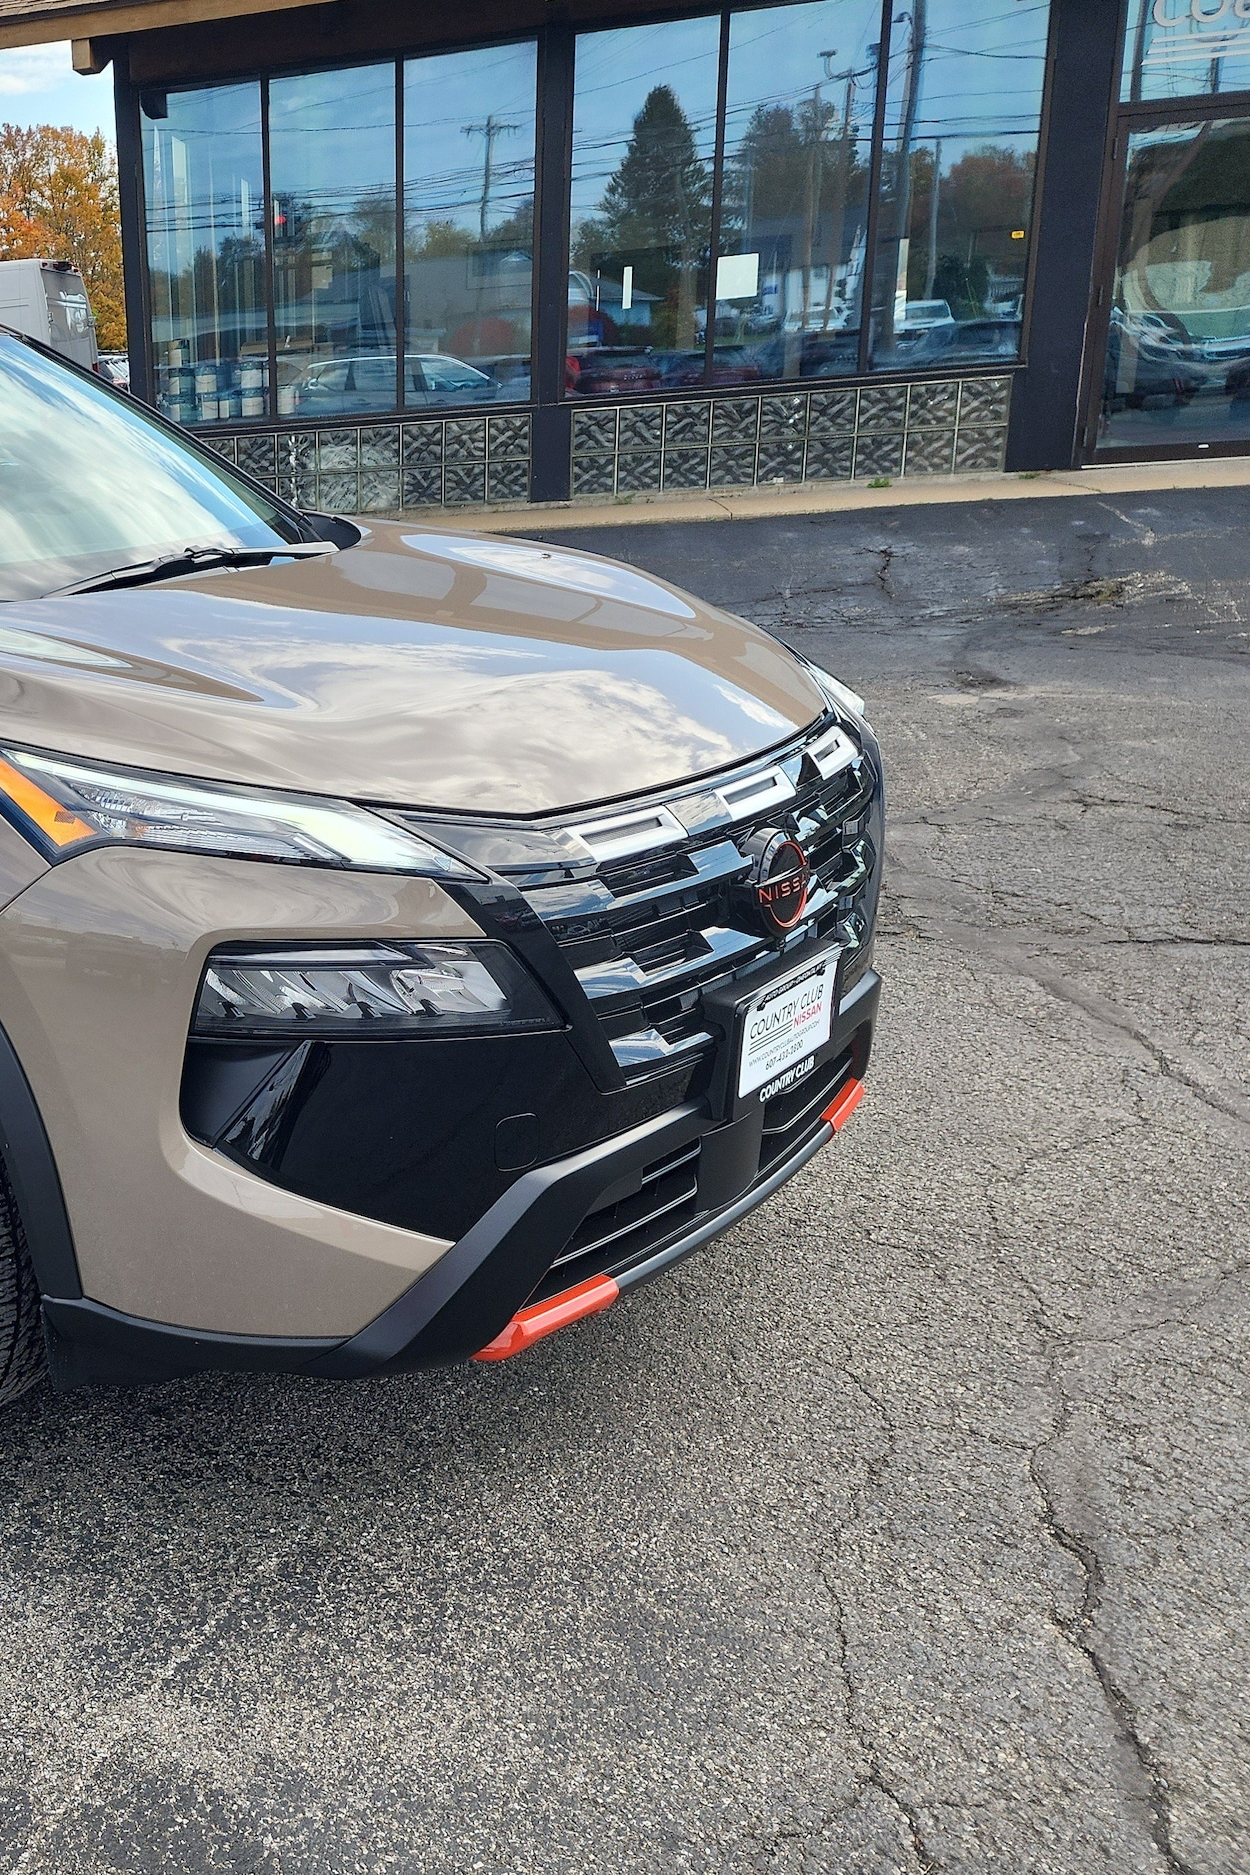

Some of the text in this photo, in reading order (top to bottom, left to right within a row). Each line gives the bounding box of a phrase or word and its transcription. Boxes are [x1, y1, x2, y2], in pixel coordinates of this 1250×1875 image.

[750, 984, 825, 1040] COUNTRY CLUB
[793, 1002, 822, 1028] NISSAN
[759, 1056, 815, 1102] COUNTRY CLUB
